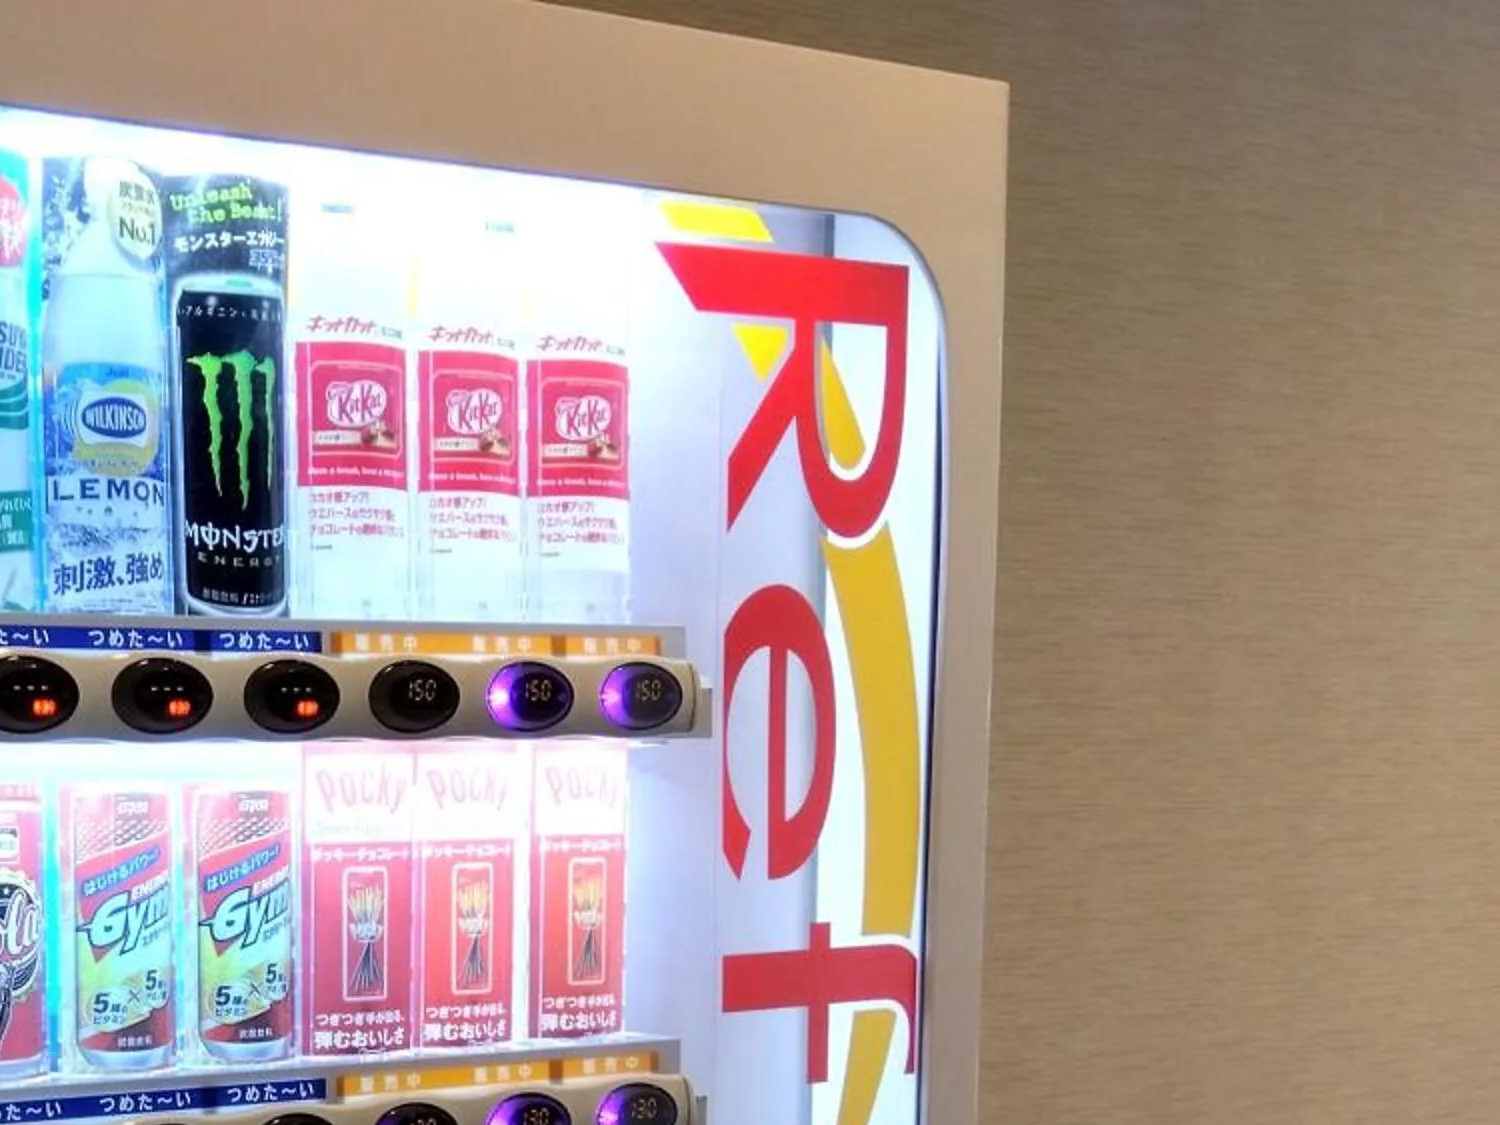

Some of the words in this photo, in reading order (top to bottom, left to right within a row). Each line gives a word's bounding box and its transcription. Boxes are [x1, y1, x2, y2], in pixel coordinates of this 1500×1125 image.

[306, 316, 378, 335] キットカット
[428, 325, 495, 344] キットカット
[536, 334, 604, 353] キットカット
[337, 382, 382, 424] KitKat
[457, 390, 500, 432] KitKat
[565, 398, 609, 438] KitKat
[53, 478, 165, 508] LEMON
[184, 519, 286, 554] MONSTE
[53, 551, 164, 596] 刺激、強め
[408, 680, 437, 702] 150
[525, 680, 553, 701] 150
[77, 881, 169, 957] Gym
[199, 877, 290, 951] Gym
